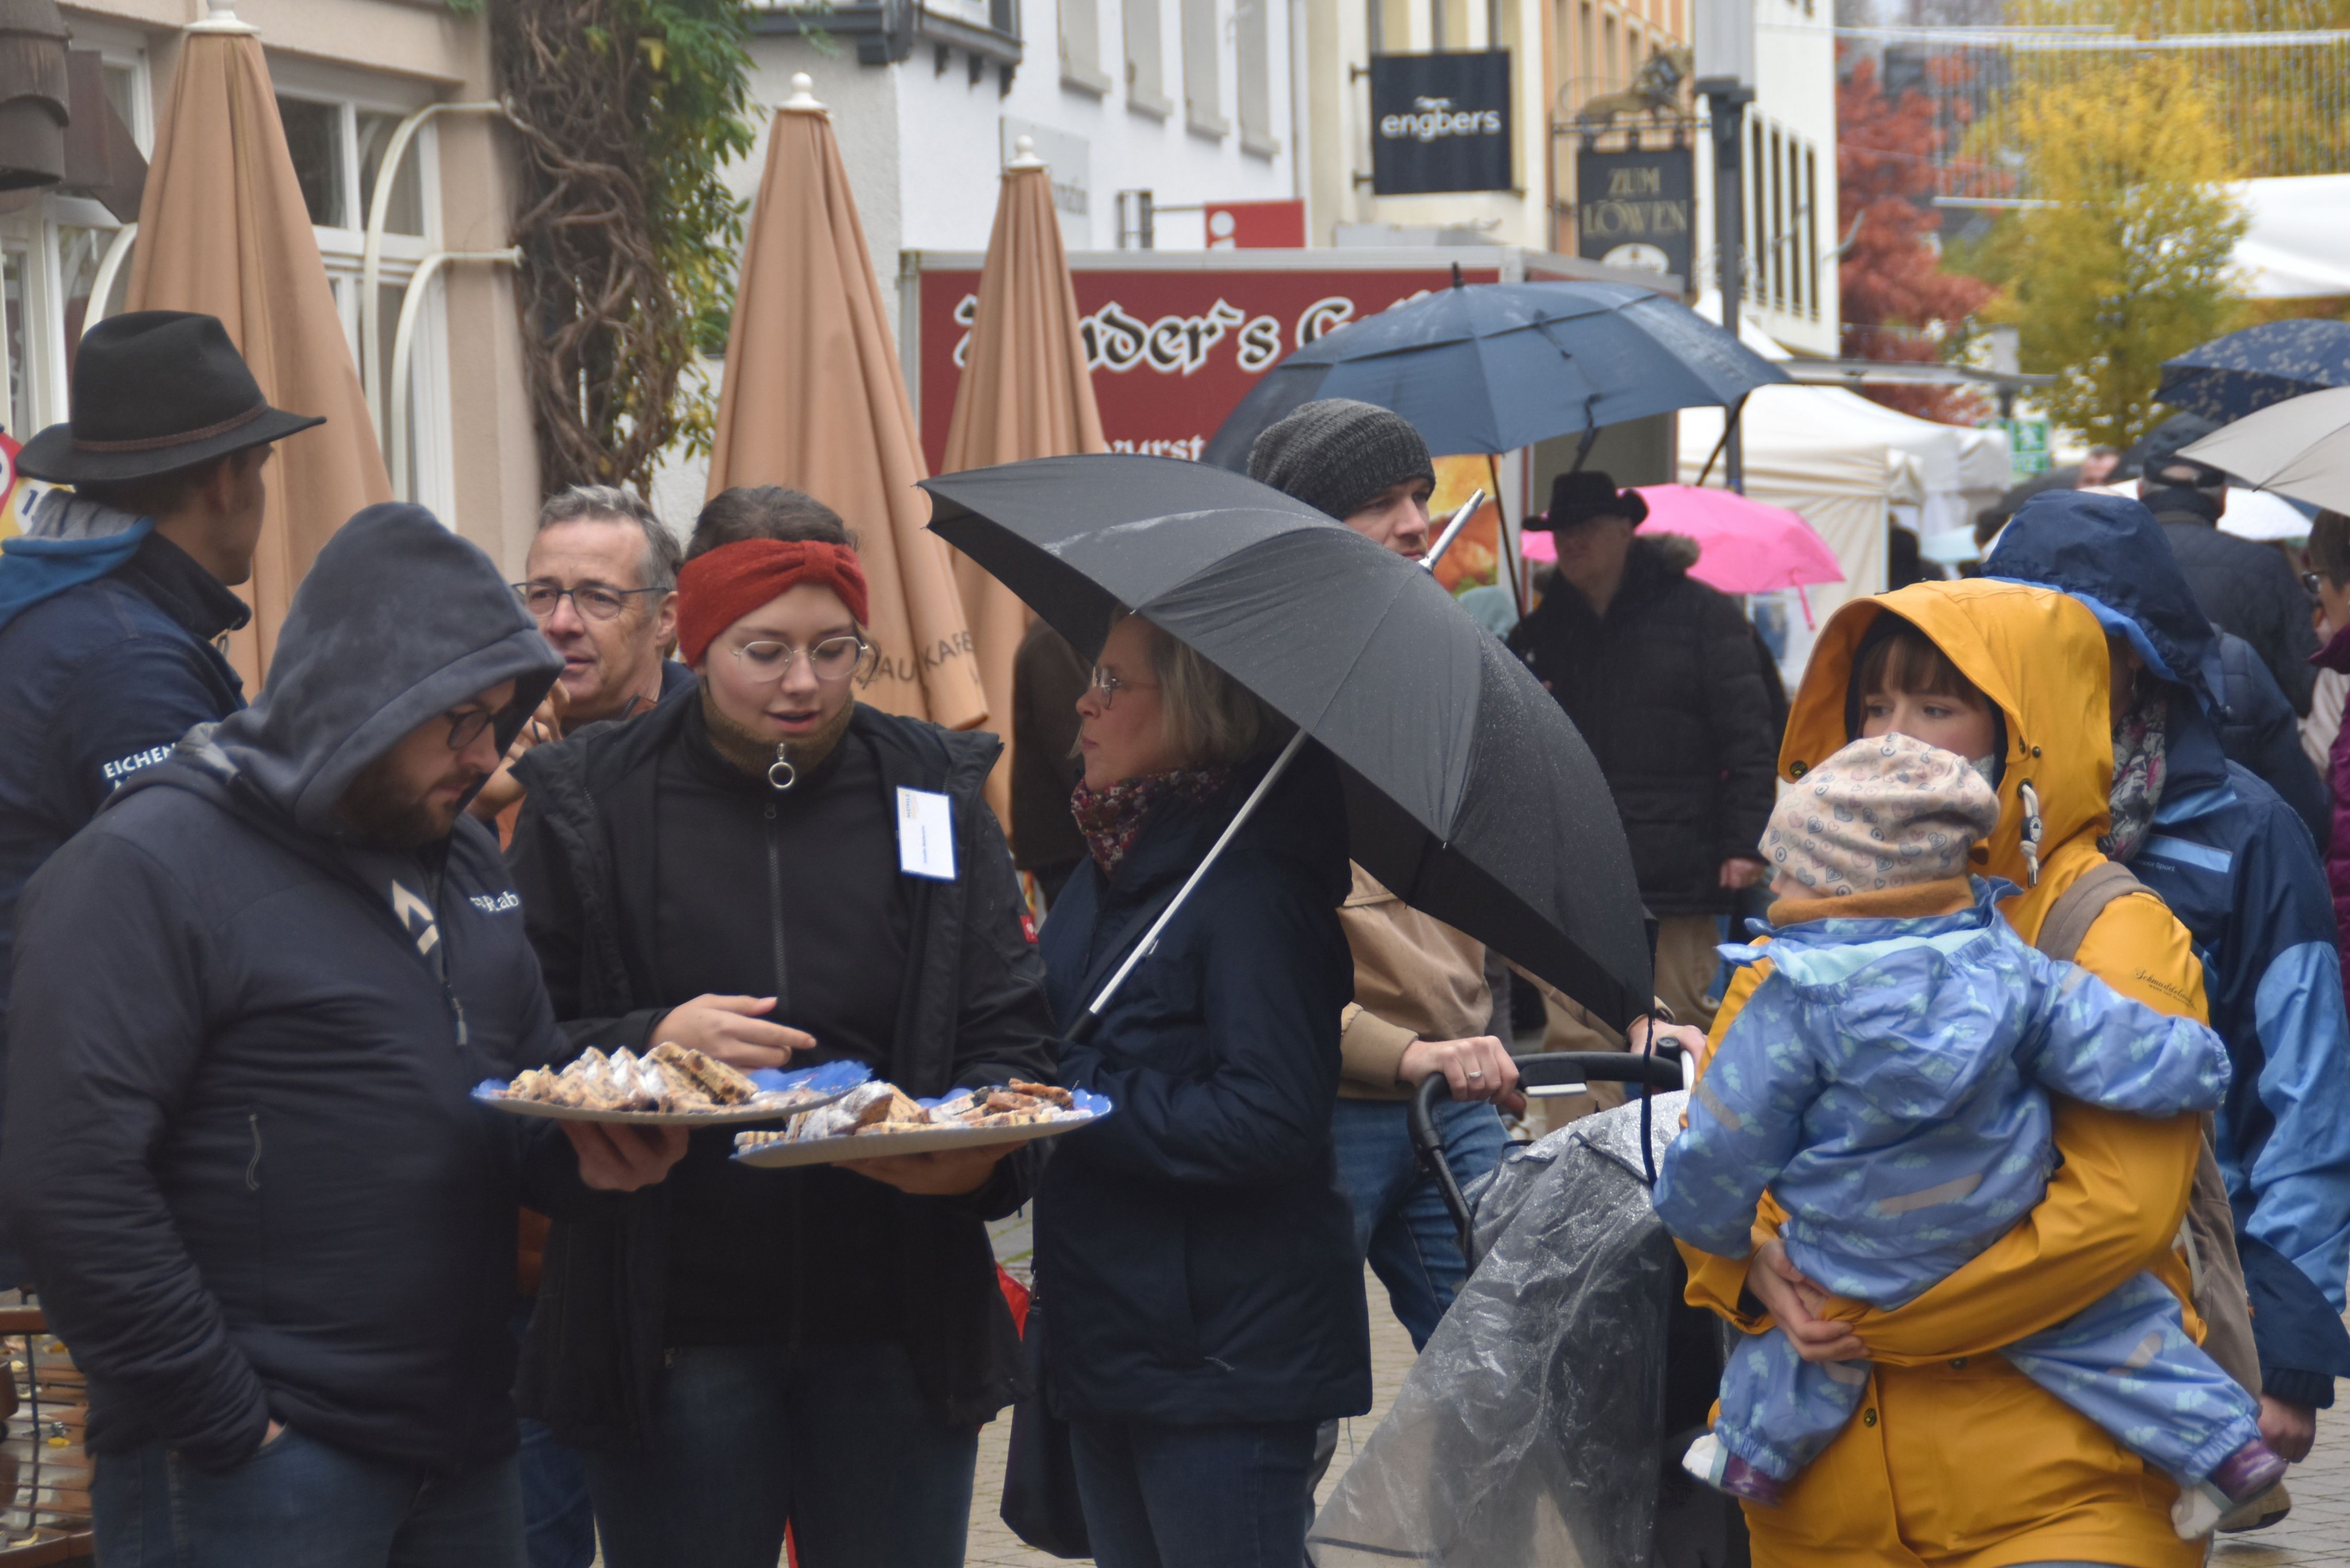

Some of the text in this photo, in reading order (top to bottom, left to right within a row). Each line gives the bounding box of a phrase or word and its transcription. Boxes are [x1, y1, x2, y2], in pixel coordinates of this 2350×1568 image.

[1380, 107, 1501, 142] engbers
[1608, 167, 1661, 194] ZUM
[2156, 862, 2176, 871] Sport
[480, 890, 519, 912] Rab
